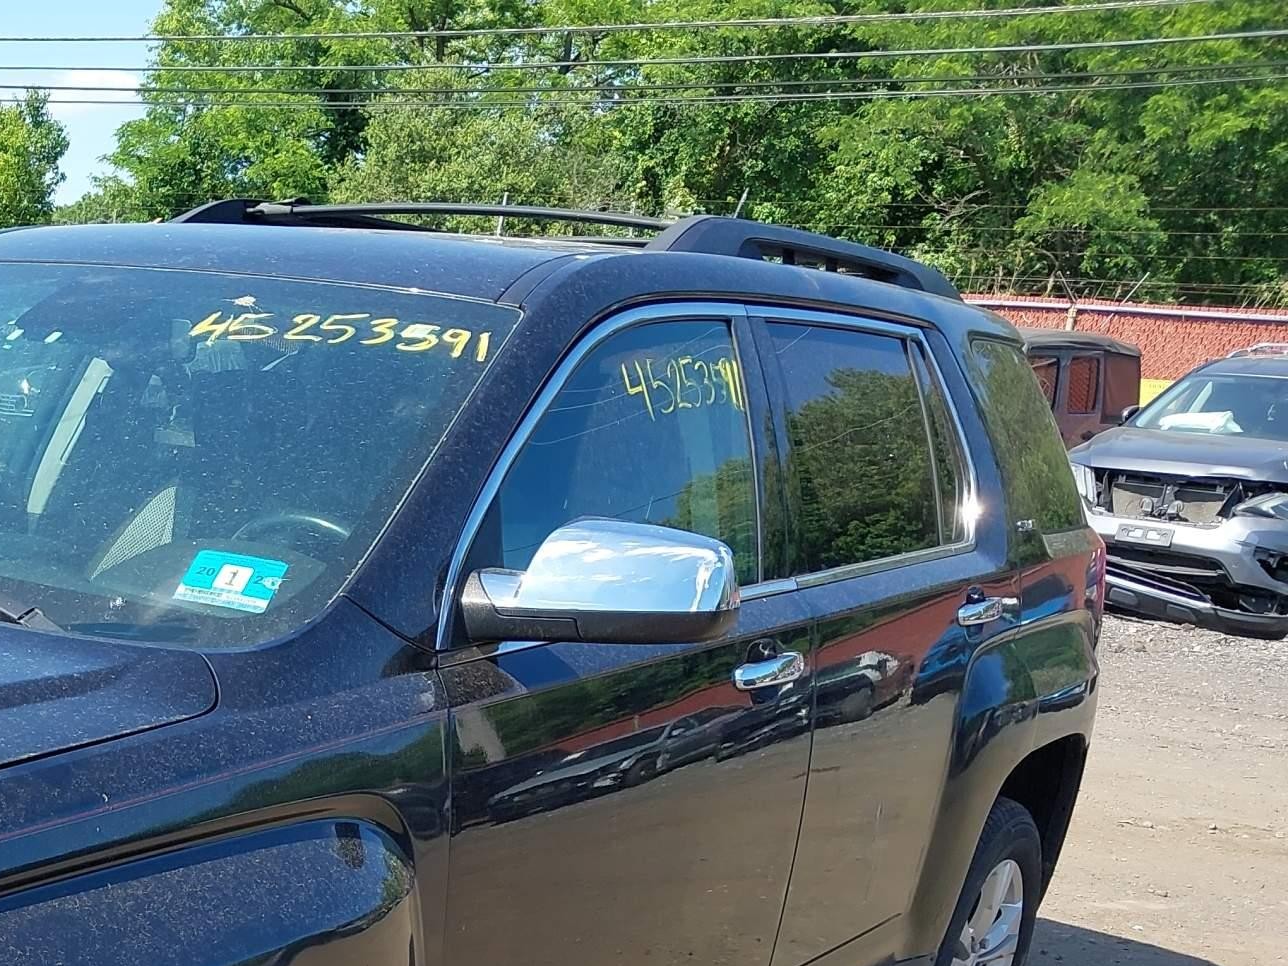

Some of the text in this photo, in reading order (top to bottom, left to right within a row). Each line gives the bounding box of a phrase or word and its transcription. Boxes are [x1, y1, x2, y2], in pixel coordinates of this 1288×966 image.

[621, 355, 745, 422] 45253591
[196, 566, 216, 577] 20
[225, 569, 239, 587] 1
